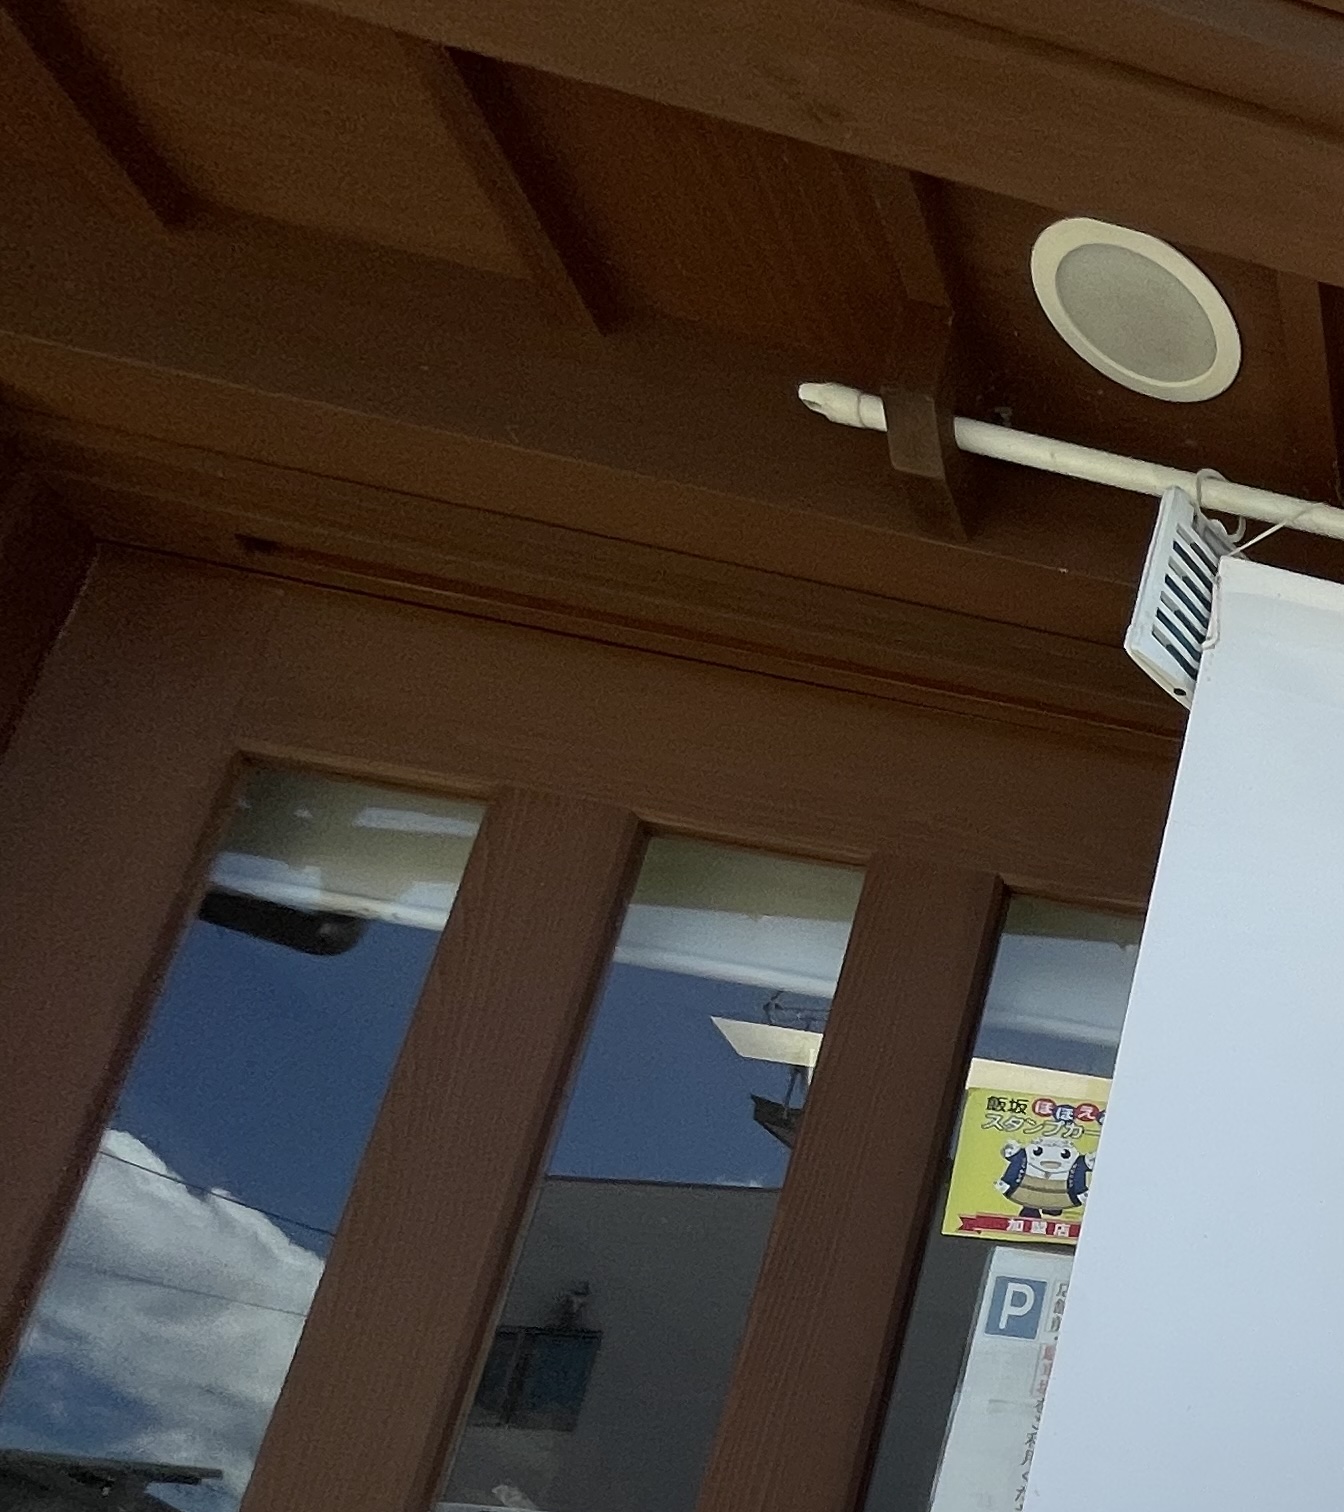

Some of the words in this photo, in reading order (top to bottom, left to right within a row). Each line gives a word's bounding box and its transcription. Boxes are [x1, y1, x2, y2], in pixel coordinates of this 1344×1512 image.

[986, 1096, 1106, 1124] 飯坂ほほえ
[999, 1282, 1034, 1330] P
